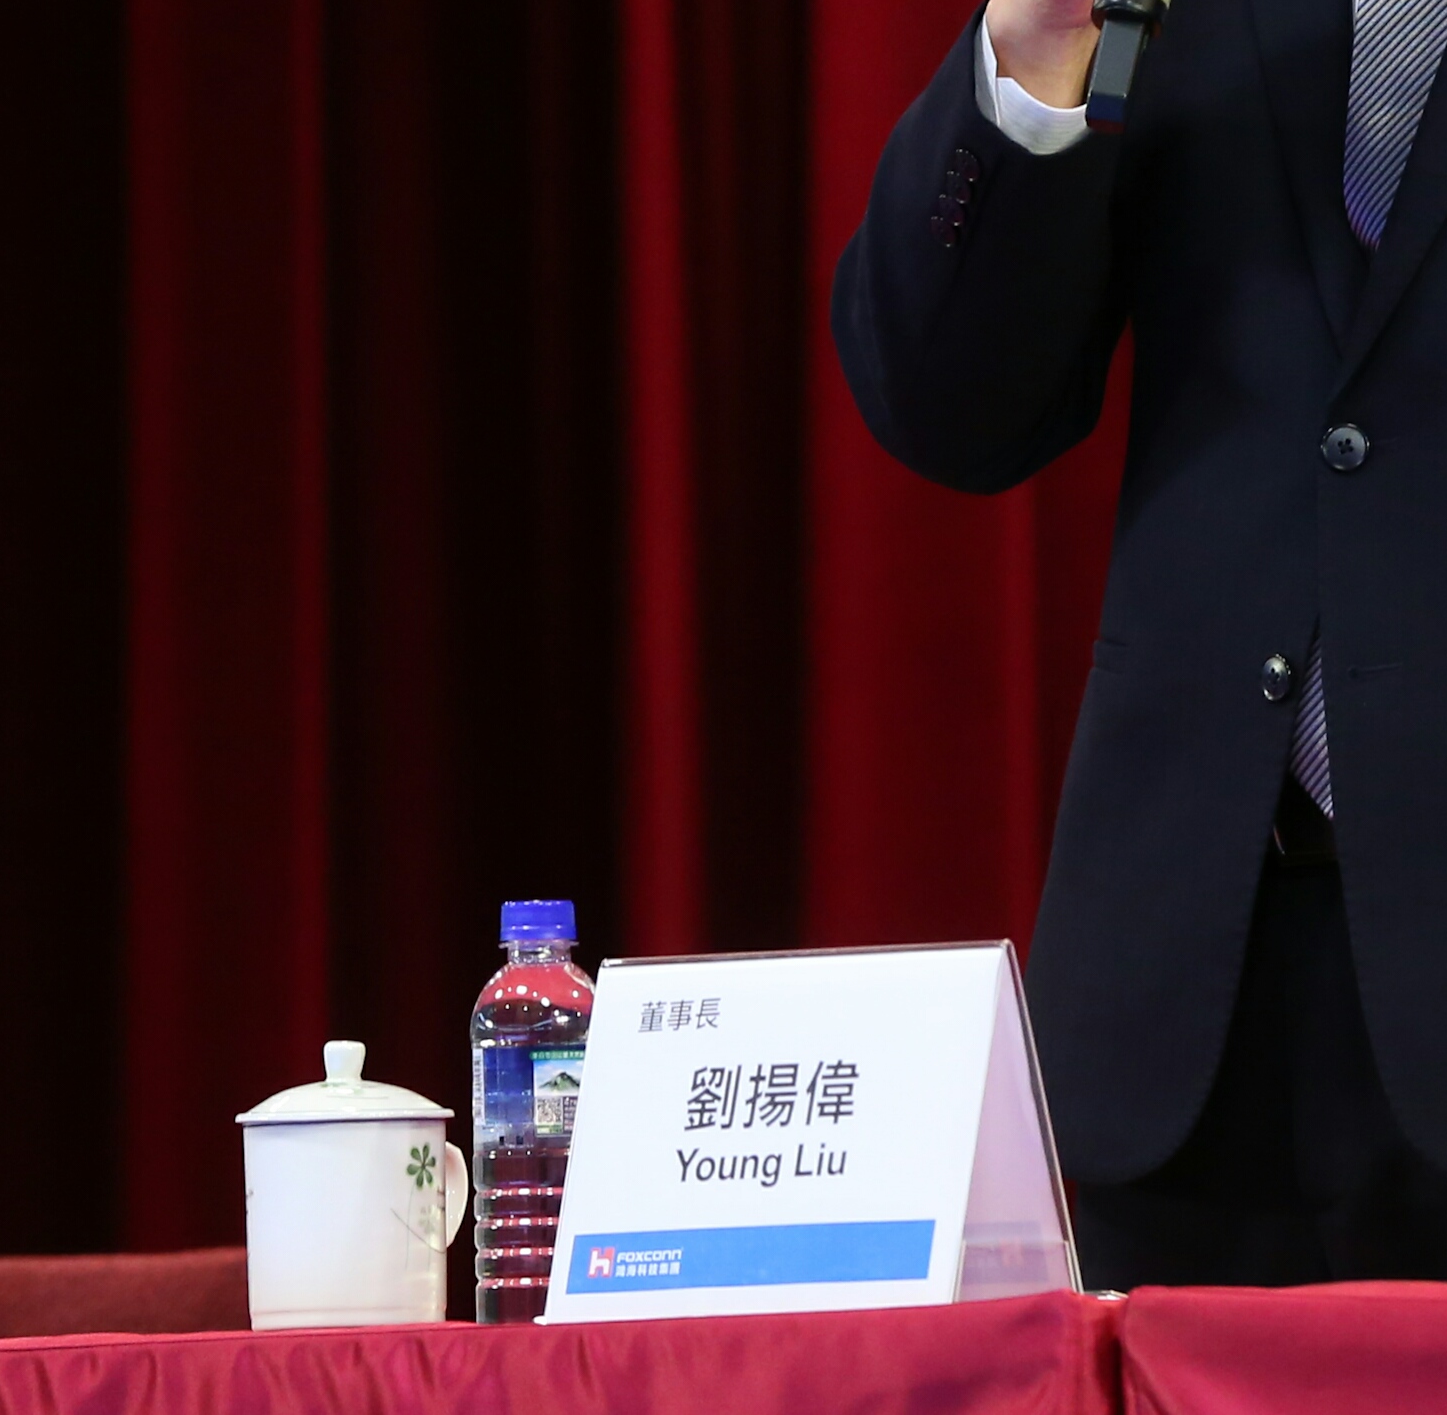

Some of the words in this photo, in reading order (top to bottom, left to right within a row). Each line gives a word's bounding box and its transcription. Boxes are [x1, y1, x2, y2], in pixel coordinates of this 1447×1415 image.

[638, 997, 721, 1033] 董事長
[684, 1059, 860, 1131] 劉揚偉
[676, 1148, 782, 1188] Young
[794, 1143, 847, 1177] Liu
